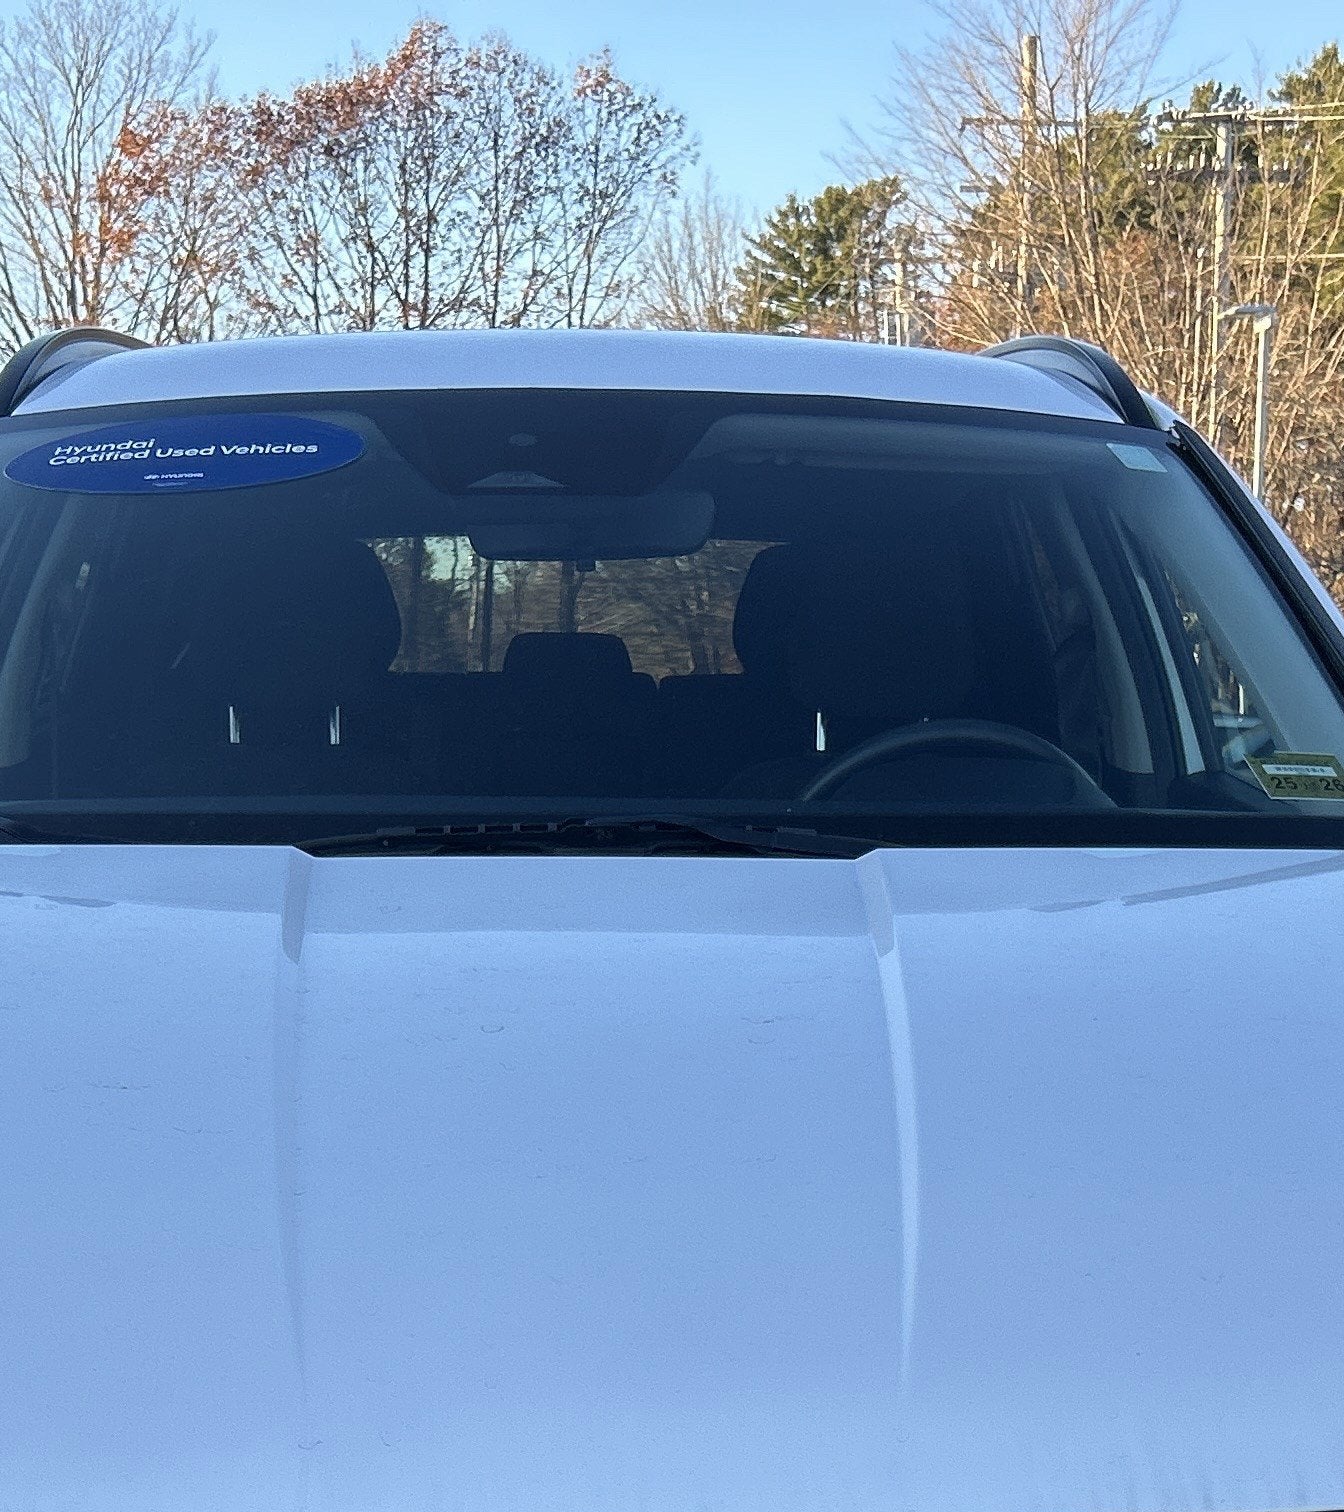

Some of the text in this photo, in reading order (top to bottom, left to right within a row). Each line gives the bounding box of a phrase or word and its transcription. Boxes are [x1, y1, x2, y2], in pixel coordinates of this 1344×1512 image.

[49, 443, 318, 466] Certified Used Vehicles
[54, 438, 156, 456] Hyundai
[1270, 776, 1298, 790] 25
